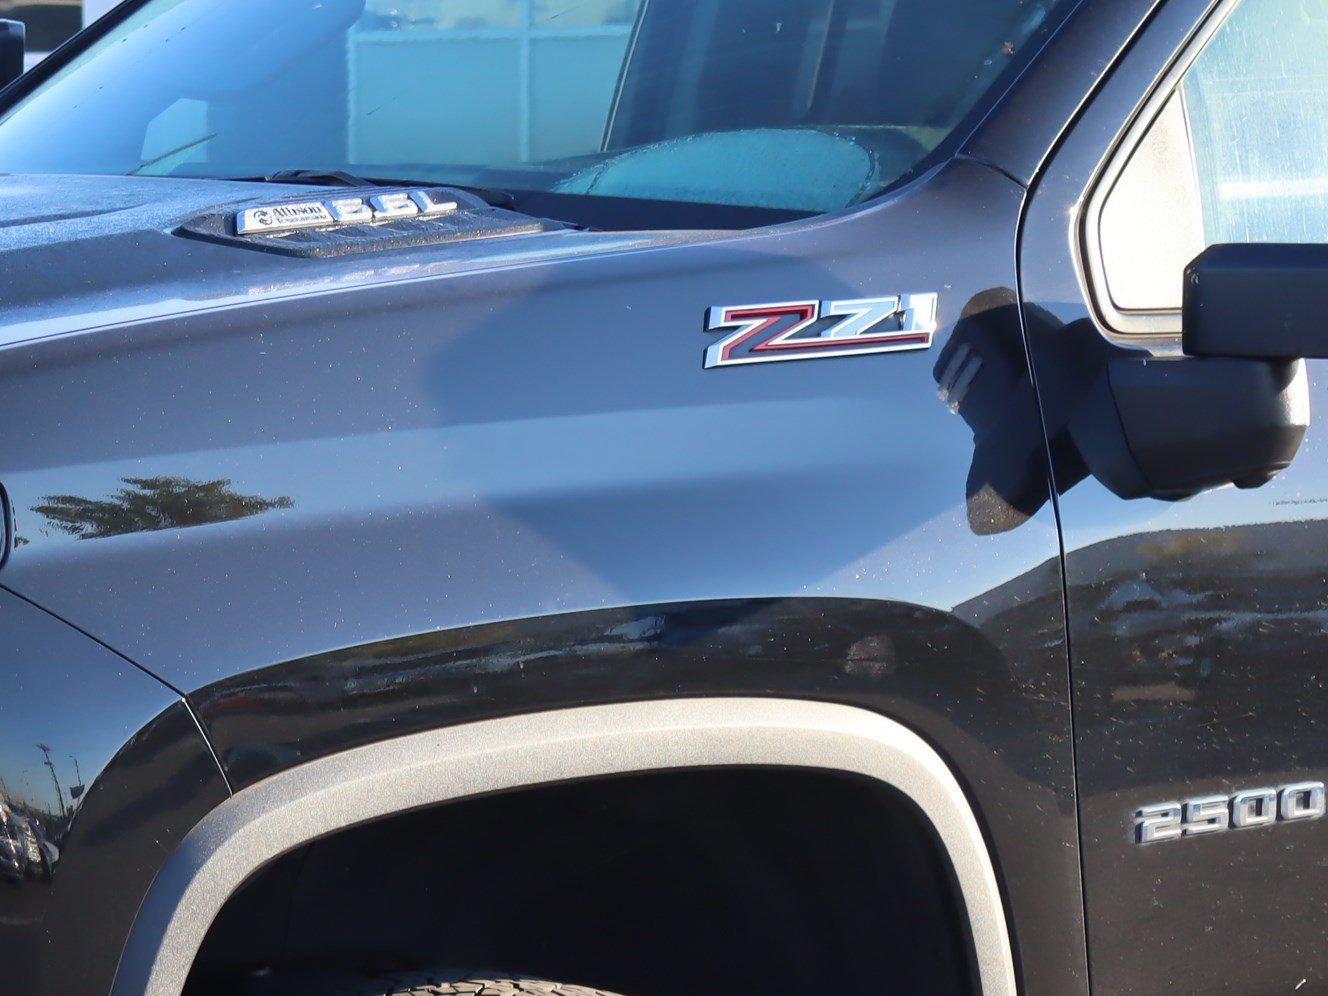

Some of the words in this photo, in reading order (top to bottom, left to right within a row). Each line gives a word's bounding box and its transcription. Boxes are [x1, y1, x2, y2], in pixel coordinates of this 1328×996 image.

[273, 204, 322, 218] Allison
[702, 292, 939, 369] Z71
[1134, 781, 1325, 845] 2500
